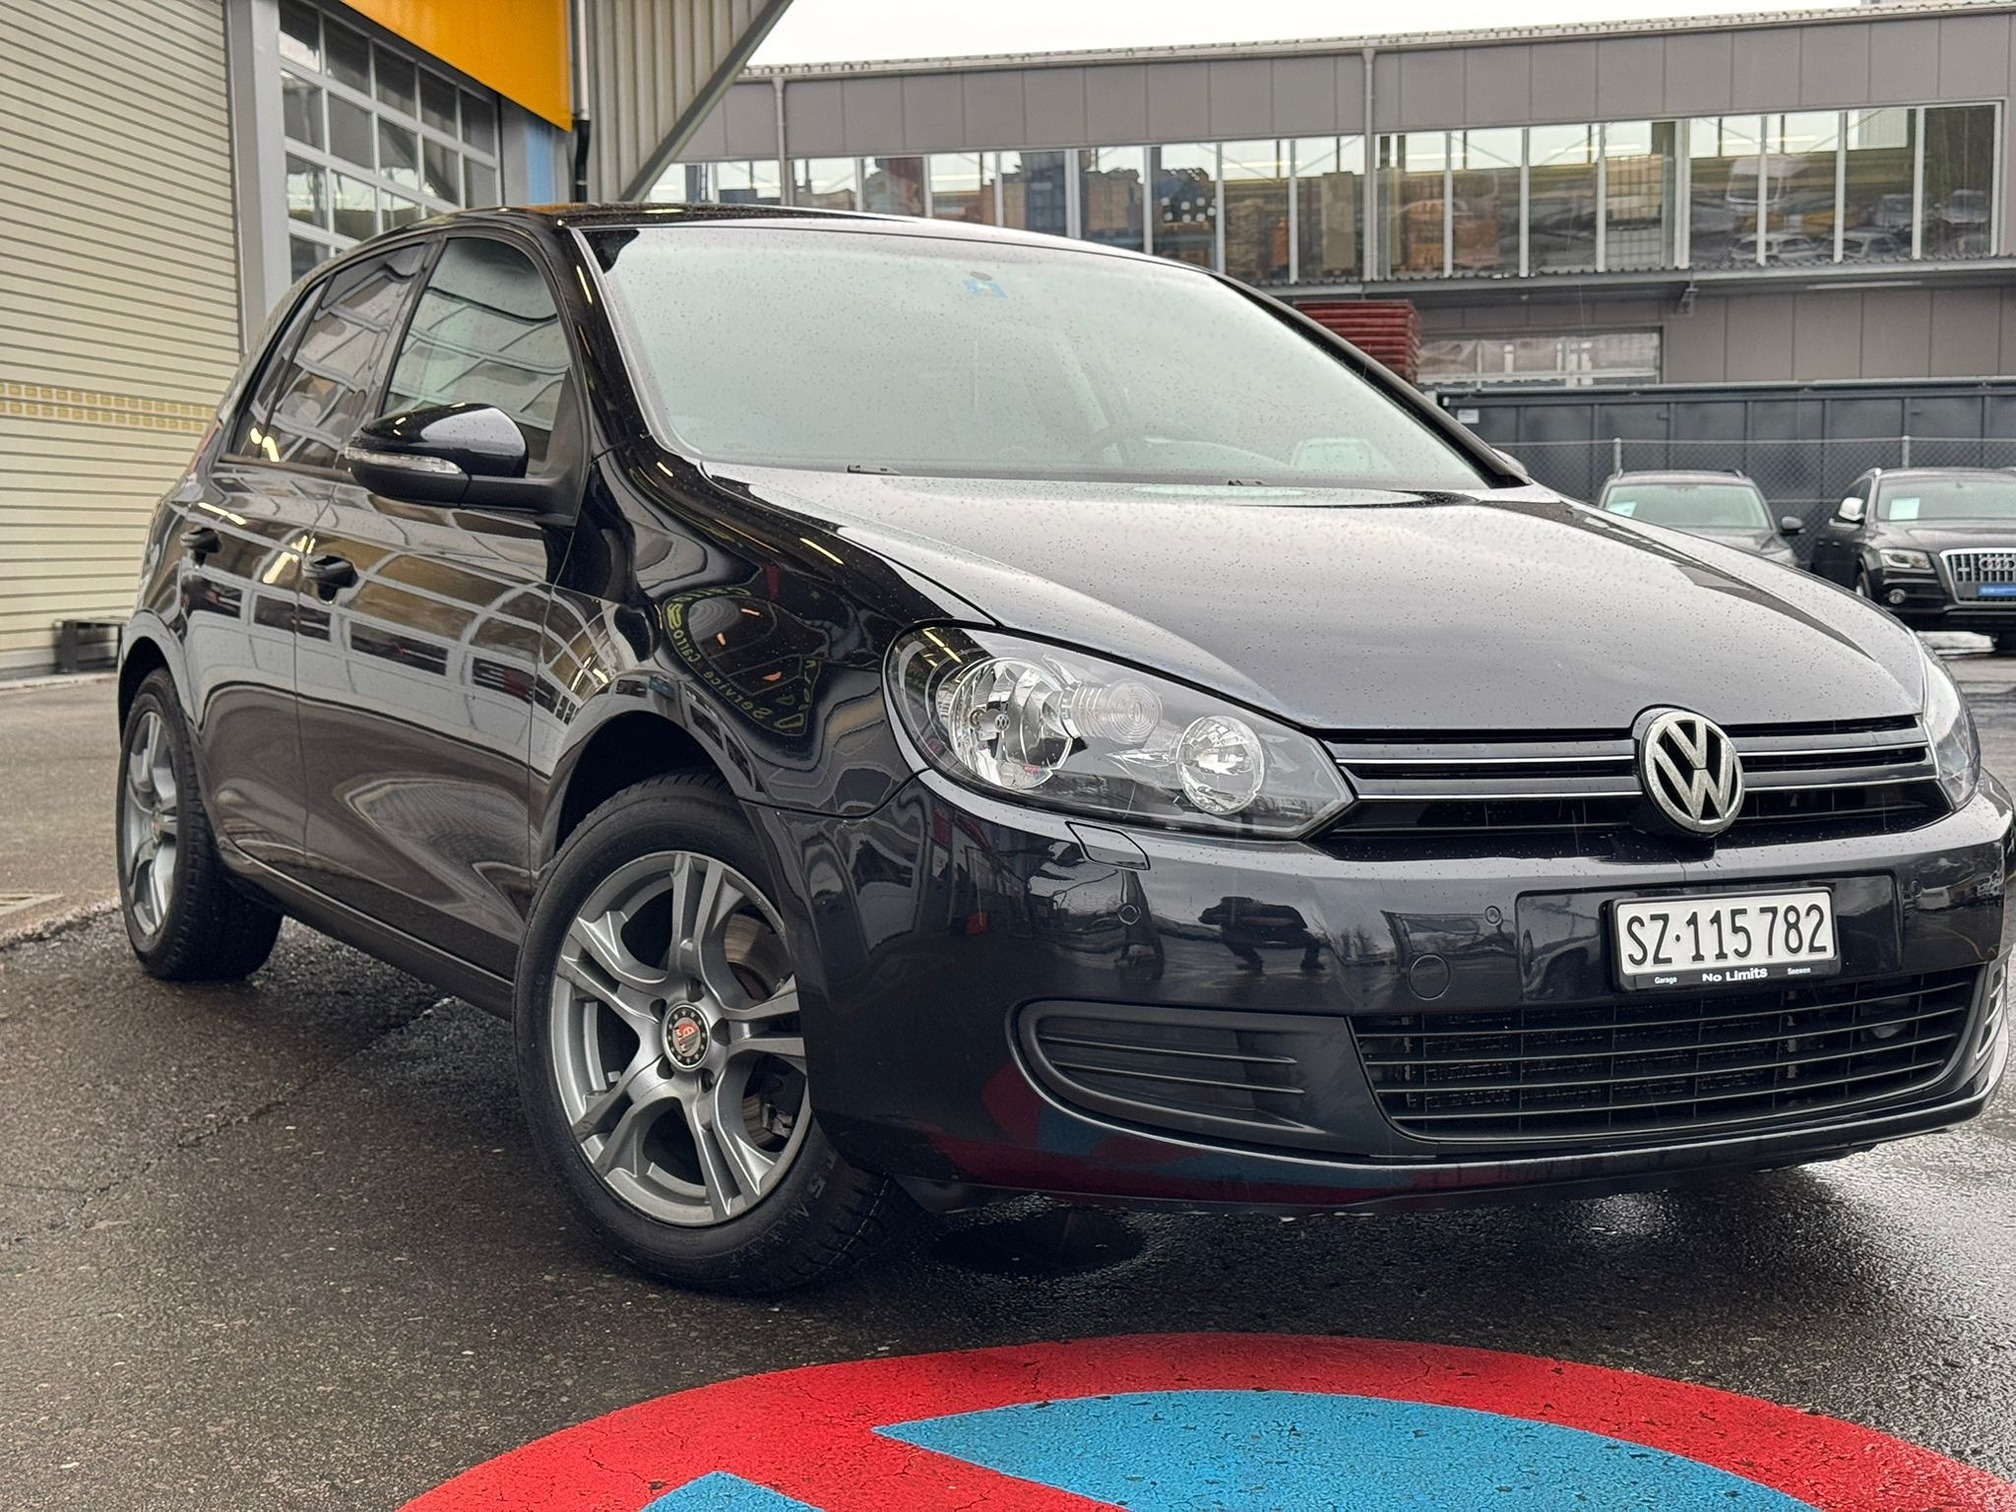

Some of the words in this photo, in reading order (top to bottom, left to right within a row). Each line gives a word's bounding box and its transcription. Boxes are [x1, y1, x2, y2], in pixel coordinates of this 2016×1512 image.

[1649, 714, 1739, 828] VW
[1654, 975, 1678, 985] Garage
[1702, 972, 1722, 982] No
[1726, 967, 1768, 982] Limits
